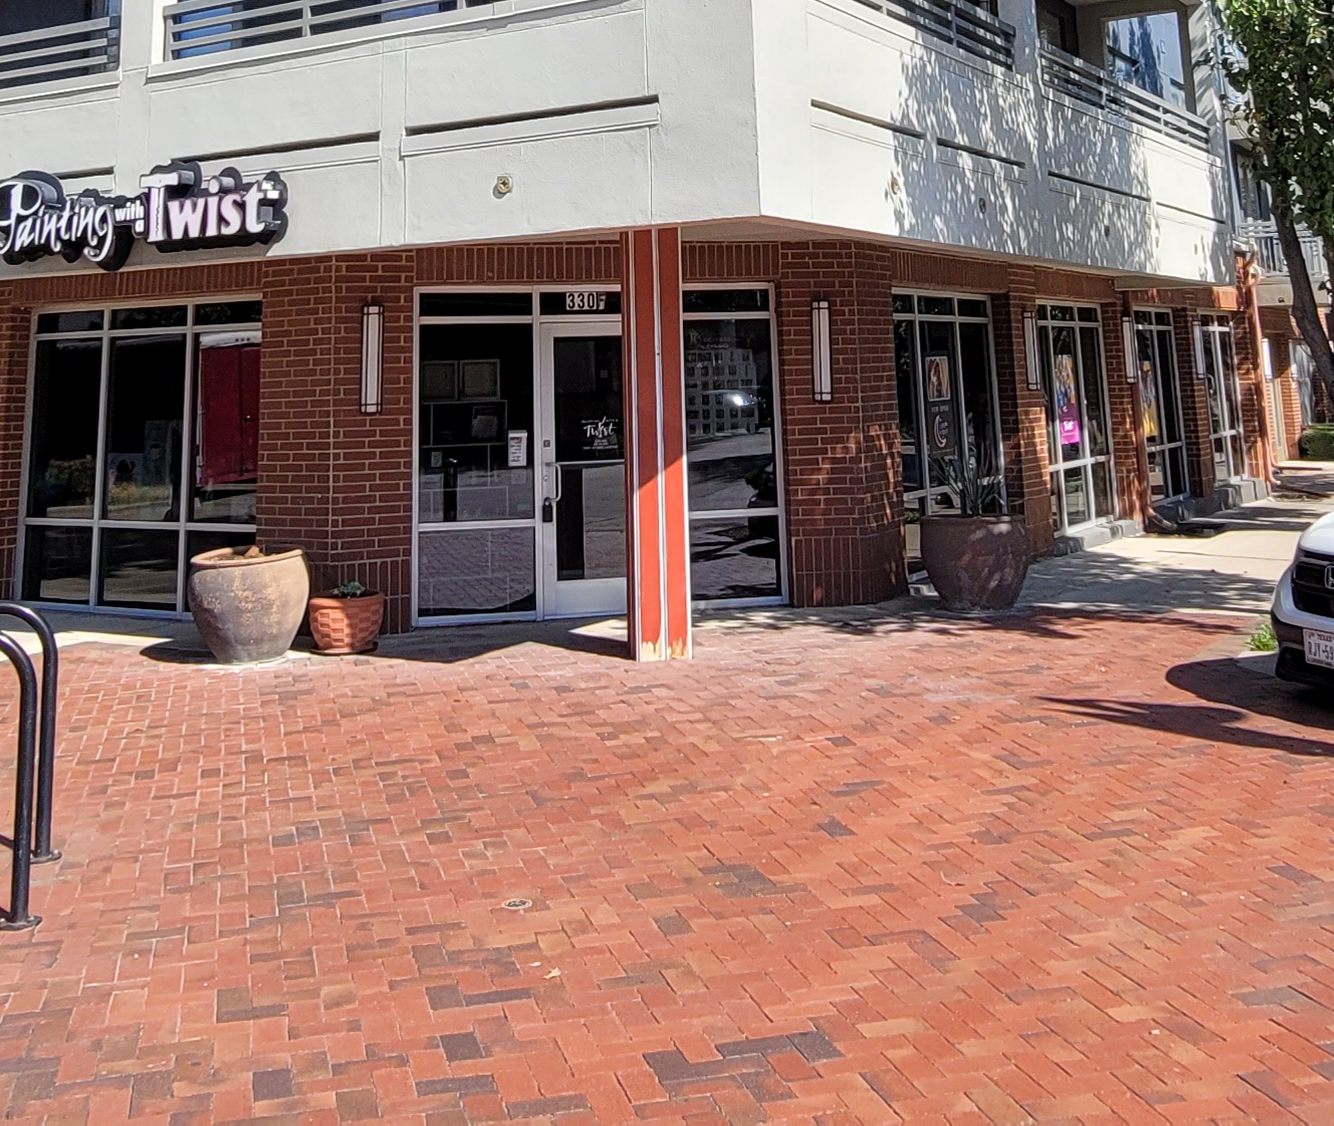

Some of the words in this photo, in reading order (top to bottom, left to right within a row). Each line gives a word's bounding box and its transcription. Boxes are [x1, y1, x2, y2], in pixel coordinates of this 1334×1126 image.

[114, 199, 144, 222] with
[139, 173, 267, 243] Twist
[135, 219, 145, 233] a
